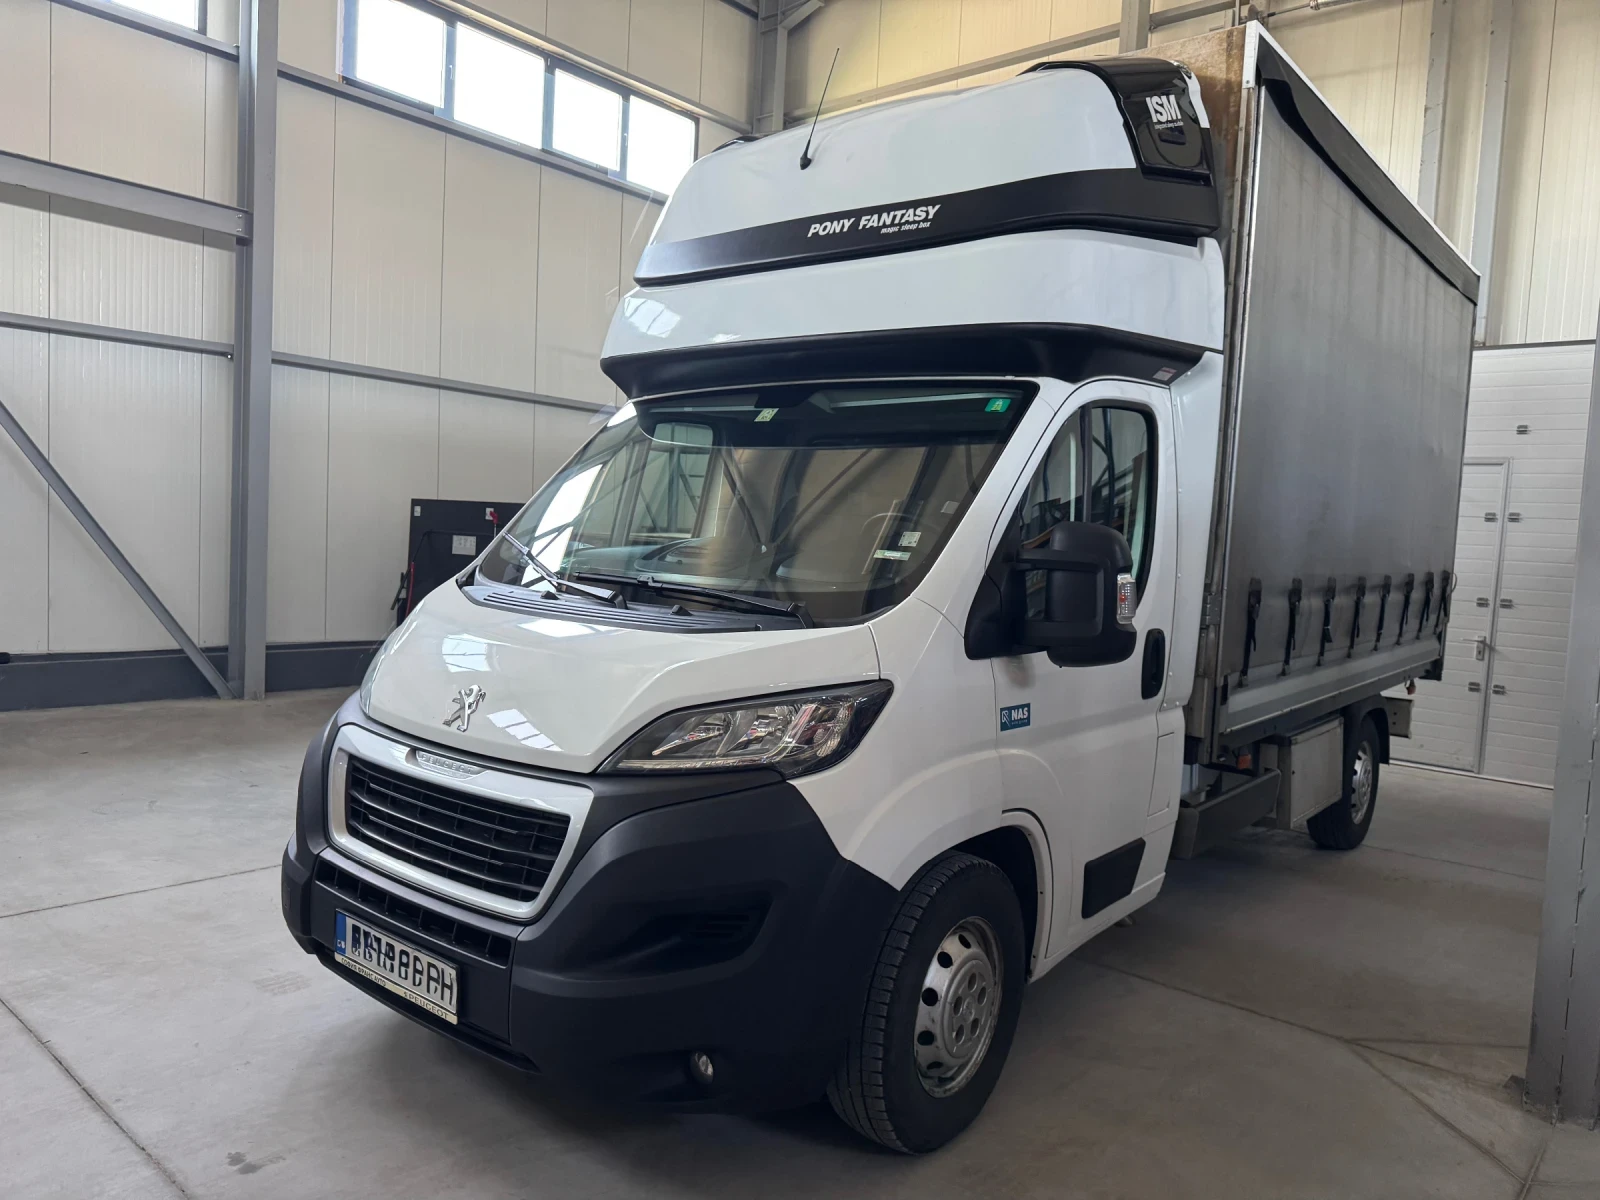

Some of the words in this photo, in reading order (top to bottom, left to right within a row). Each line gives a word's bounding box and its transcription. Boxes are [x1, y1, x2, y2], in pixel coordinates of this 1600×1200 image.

[1145, 94, 1182, 123] ISM
[807, 217, 856, 238] PONY
[858, 204, 941, 230] FANTASY
[880, 225, 900, 234] magic
[900, 222, 917, 231] sleep
[918, 221, 931, 229] box
[1011, 707, 1029, 721] NAS
[421, 753, 473, 774] PEUGEOT
[408, 993, 449, 1020] PEUGEOT
